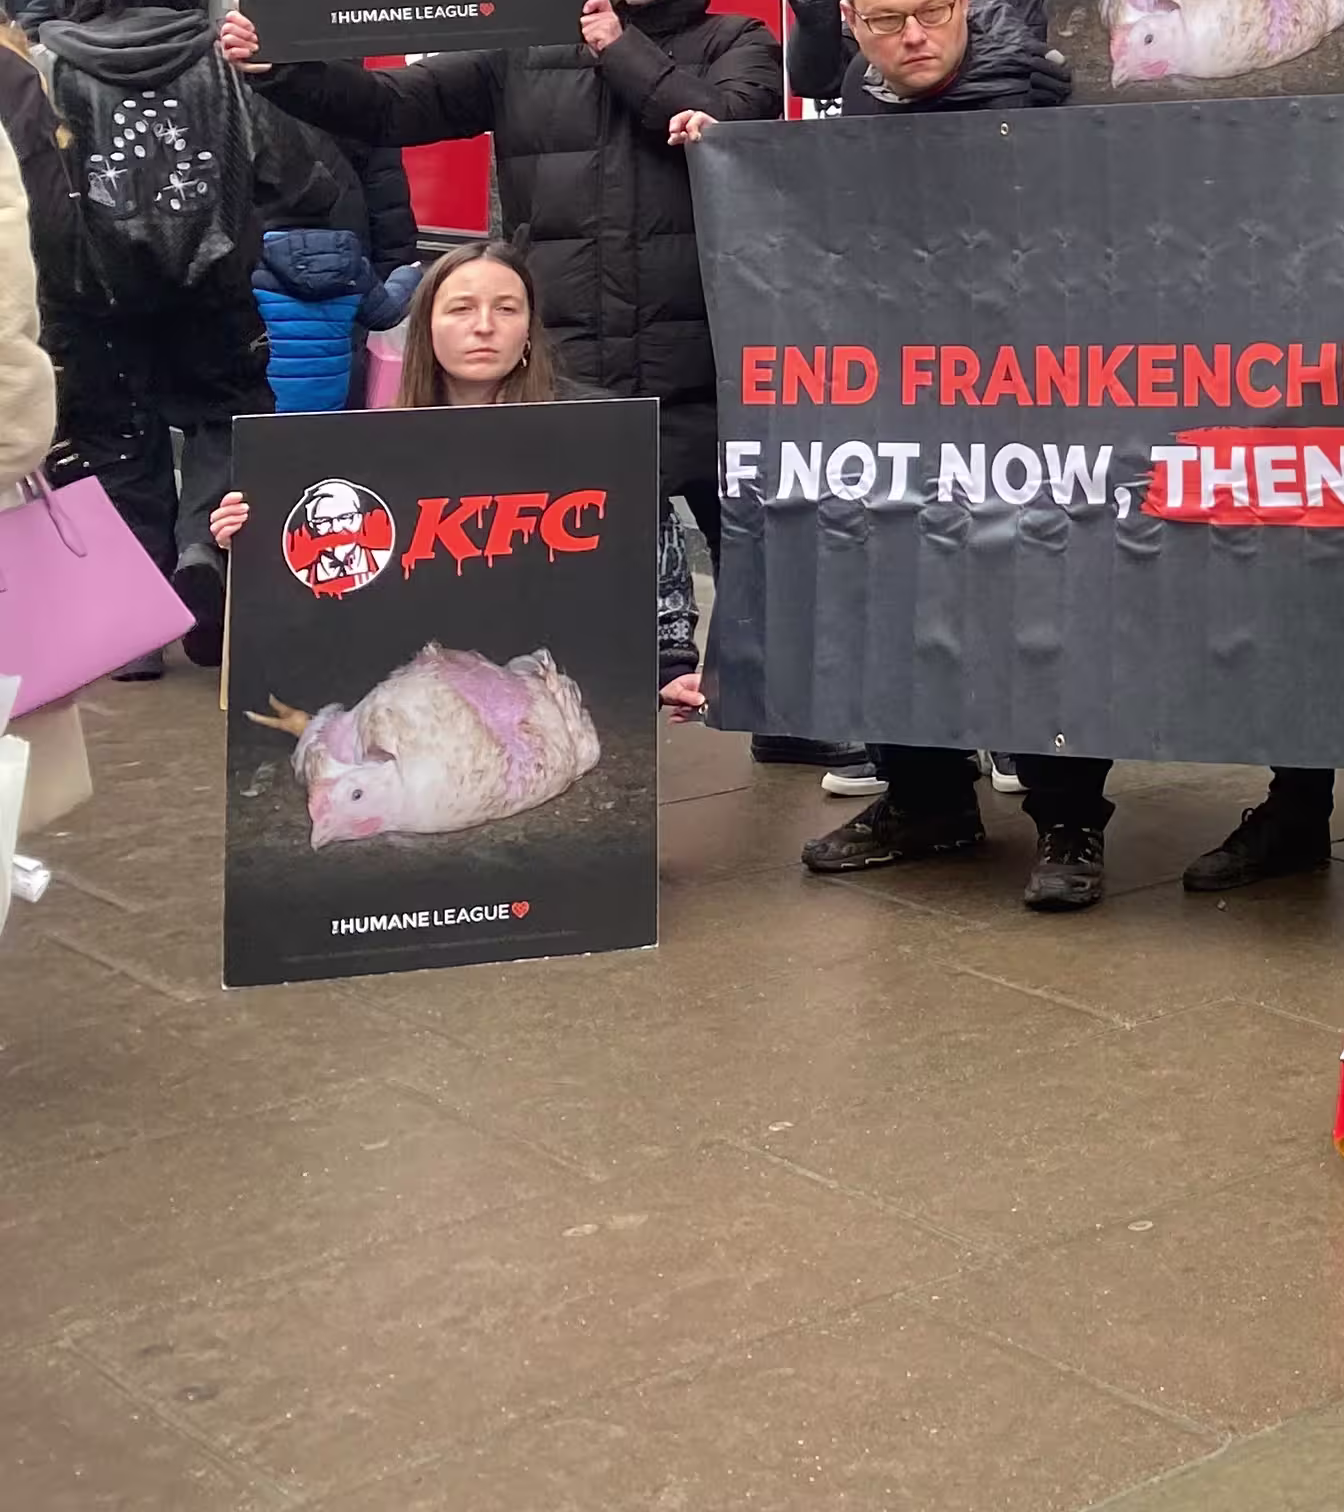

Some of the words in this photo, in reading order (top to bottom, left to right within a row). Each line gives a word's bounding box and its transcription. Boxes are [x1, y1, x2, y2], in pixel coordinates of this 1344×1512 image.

[339, 8, 412, 23] HUMANE
[416, 4, 478, 19] LEAGUE
[743, 346, 878, 404] END
[775, 440, 921, 501] NOT
[937, 442, 1133, 520] NOW,
[402, 490, 606, 576] KFC
[341, 912, 429, 934] HUMANE
[434, 904, 509, 925] LEAGUE
